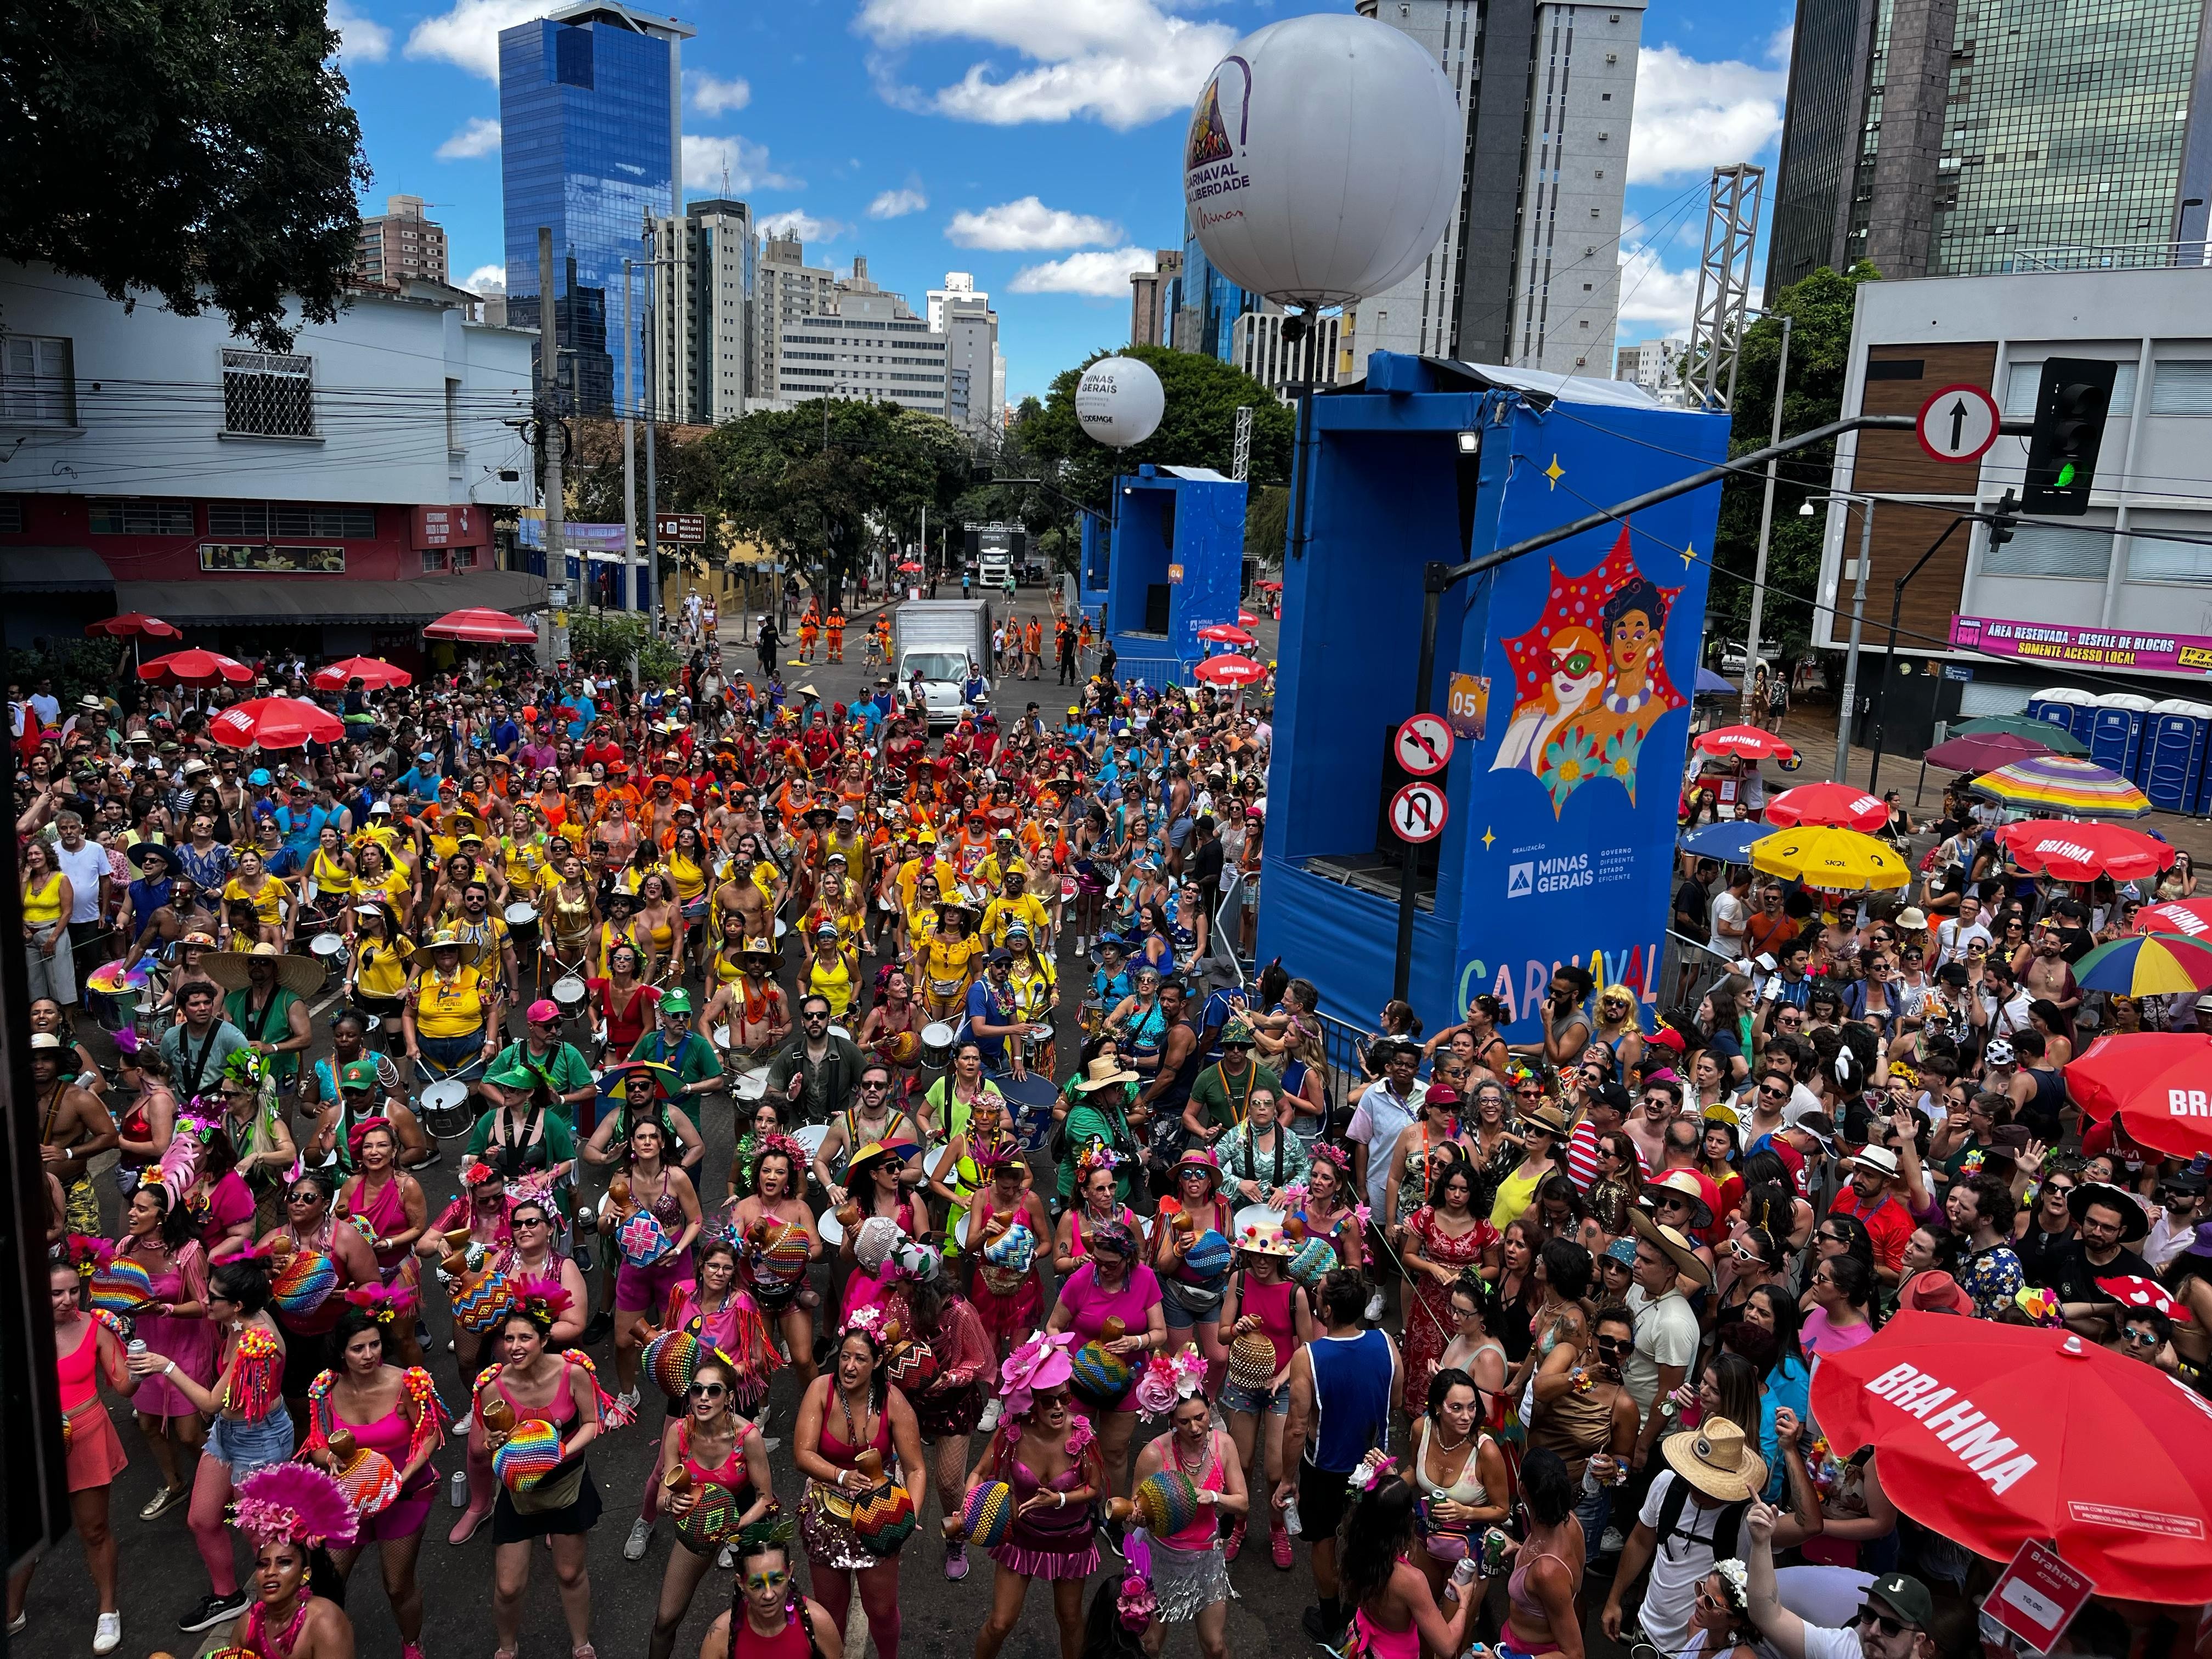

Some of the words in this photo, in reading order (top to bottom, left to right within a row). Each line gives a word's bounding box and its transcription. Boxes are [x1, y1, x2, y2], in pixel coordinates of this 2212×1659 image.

[1186, 163, 1239, 189] CARNAVAL
[1192, 176, 1250, 202] LIBERDADE
[1082, 384, 1117, 393] GERAIS
[1085, 375, 1114, 383] MINAS
[1082, 415, 1113, 423] CODEMGE
[1957, 627, 1980, 645] BH
[1987, 622, 2012, 638] ÁREA
[2014, 627, 2069, 644] RESERVADA
[2078, 633, 2116, 648] DESFILE
[2118, 636, 2131, 649] DE
[2134, 637, 2175, 652] BLOCOS
[2018, 642, 2062, 657] SOMENTE
[2063, 646, 2103, 662] ACESSO
[2104, 651, 2136, 665] LOCAL
[1219, 666, 1249, 674] BRAHMA
[1453, 691, 1475, 717] 05
[1718, 735, 1762, 748] BRAHMA
[1513, 843, 1545, 854] REALIZAÇÃO
[1601, 848, 1631, 856] GOVERNO
[2034, 839, 2095, 865] BRAHMA
[1538, 854, 1588, 875] MINAS
[1537, 870, 1594, 893] GERAIS
[1458, 944, 1657, 1024] CARAVAL
[2168, 1090, 2212, 1117] BR
[1864, 1362, 2038, 1496] BRAHMA
[2031, 1551, 2080, 1590] Brahma
[1888, 1579, 1904, 1592] J
